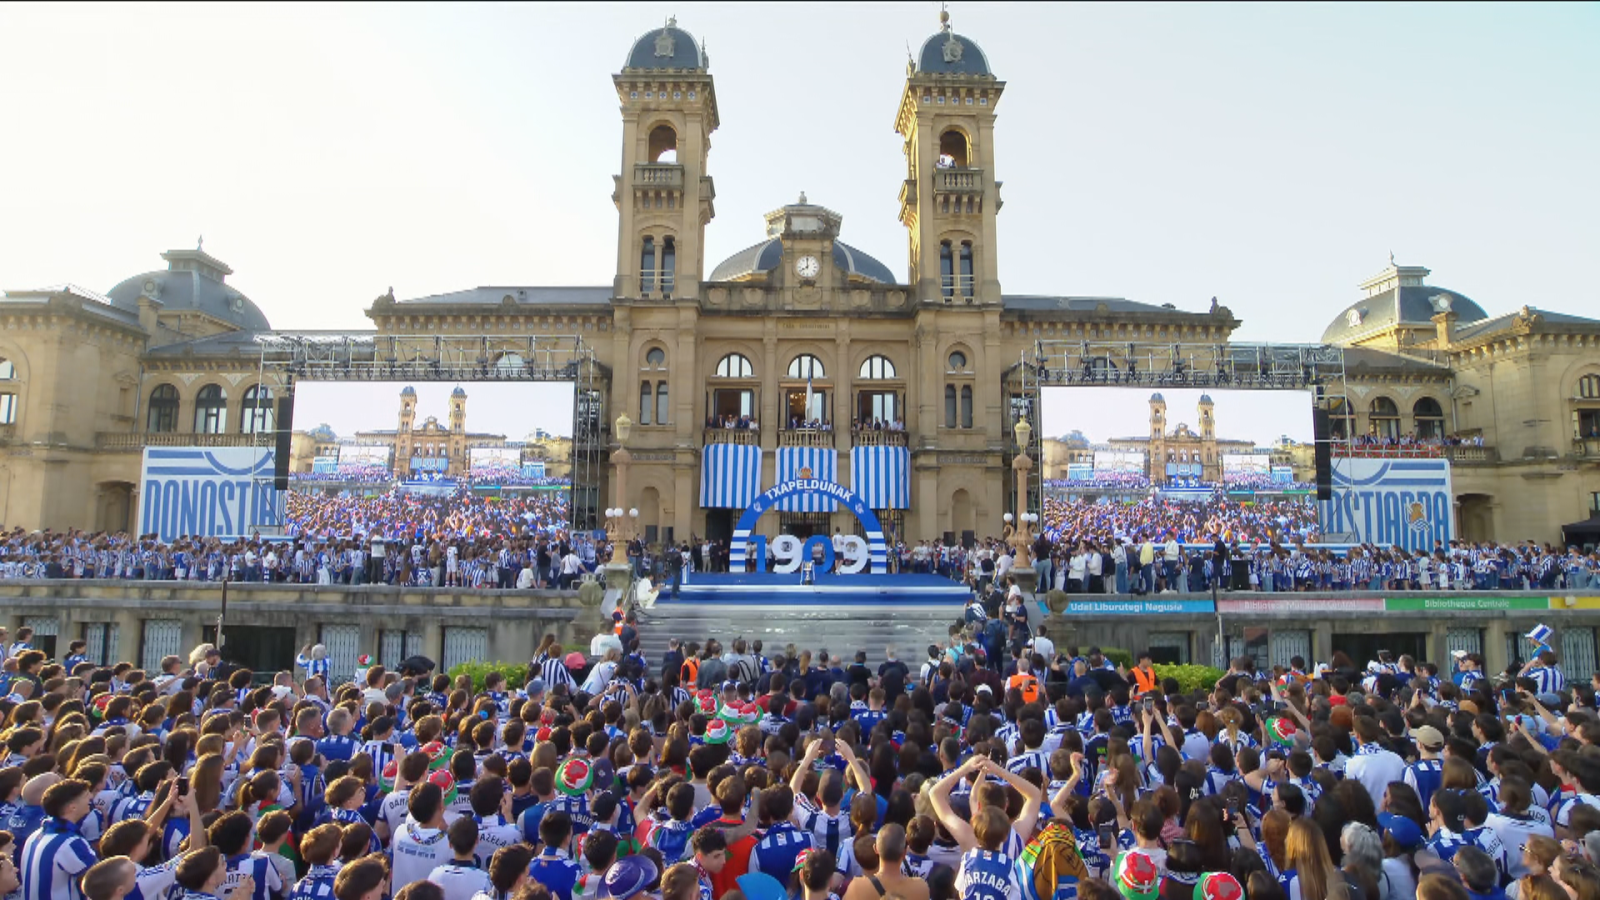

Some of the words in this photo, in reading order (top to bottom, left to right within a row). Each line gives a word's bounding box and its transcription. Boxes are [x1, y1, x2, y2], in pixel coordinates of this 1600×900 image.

[764, 479, 853, 503] TXAPELDUNAK
[748, 534, 868, 574] 1909
[1070, 603, 1092, 611] Udal
[1094, 602, 1143, 613] Liburutegi
[1145, 602, 1183, 613] Nagusia
[1244, 601, 1284, 610] Biblioteca
[1477, 599, 1510, 608] Centrale
